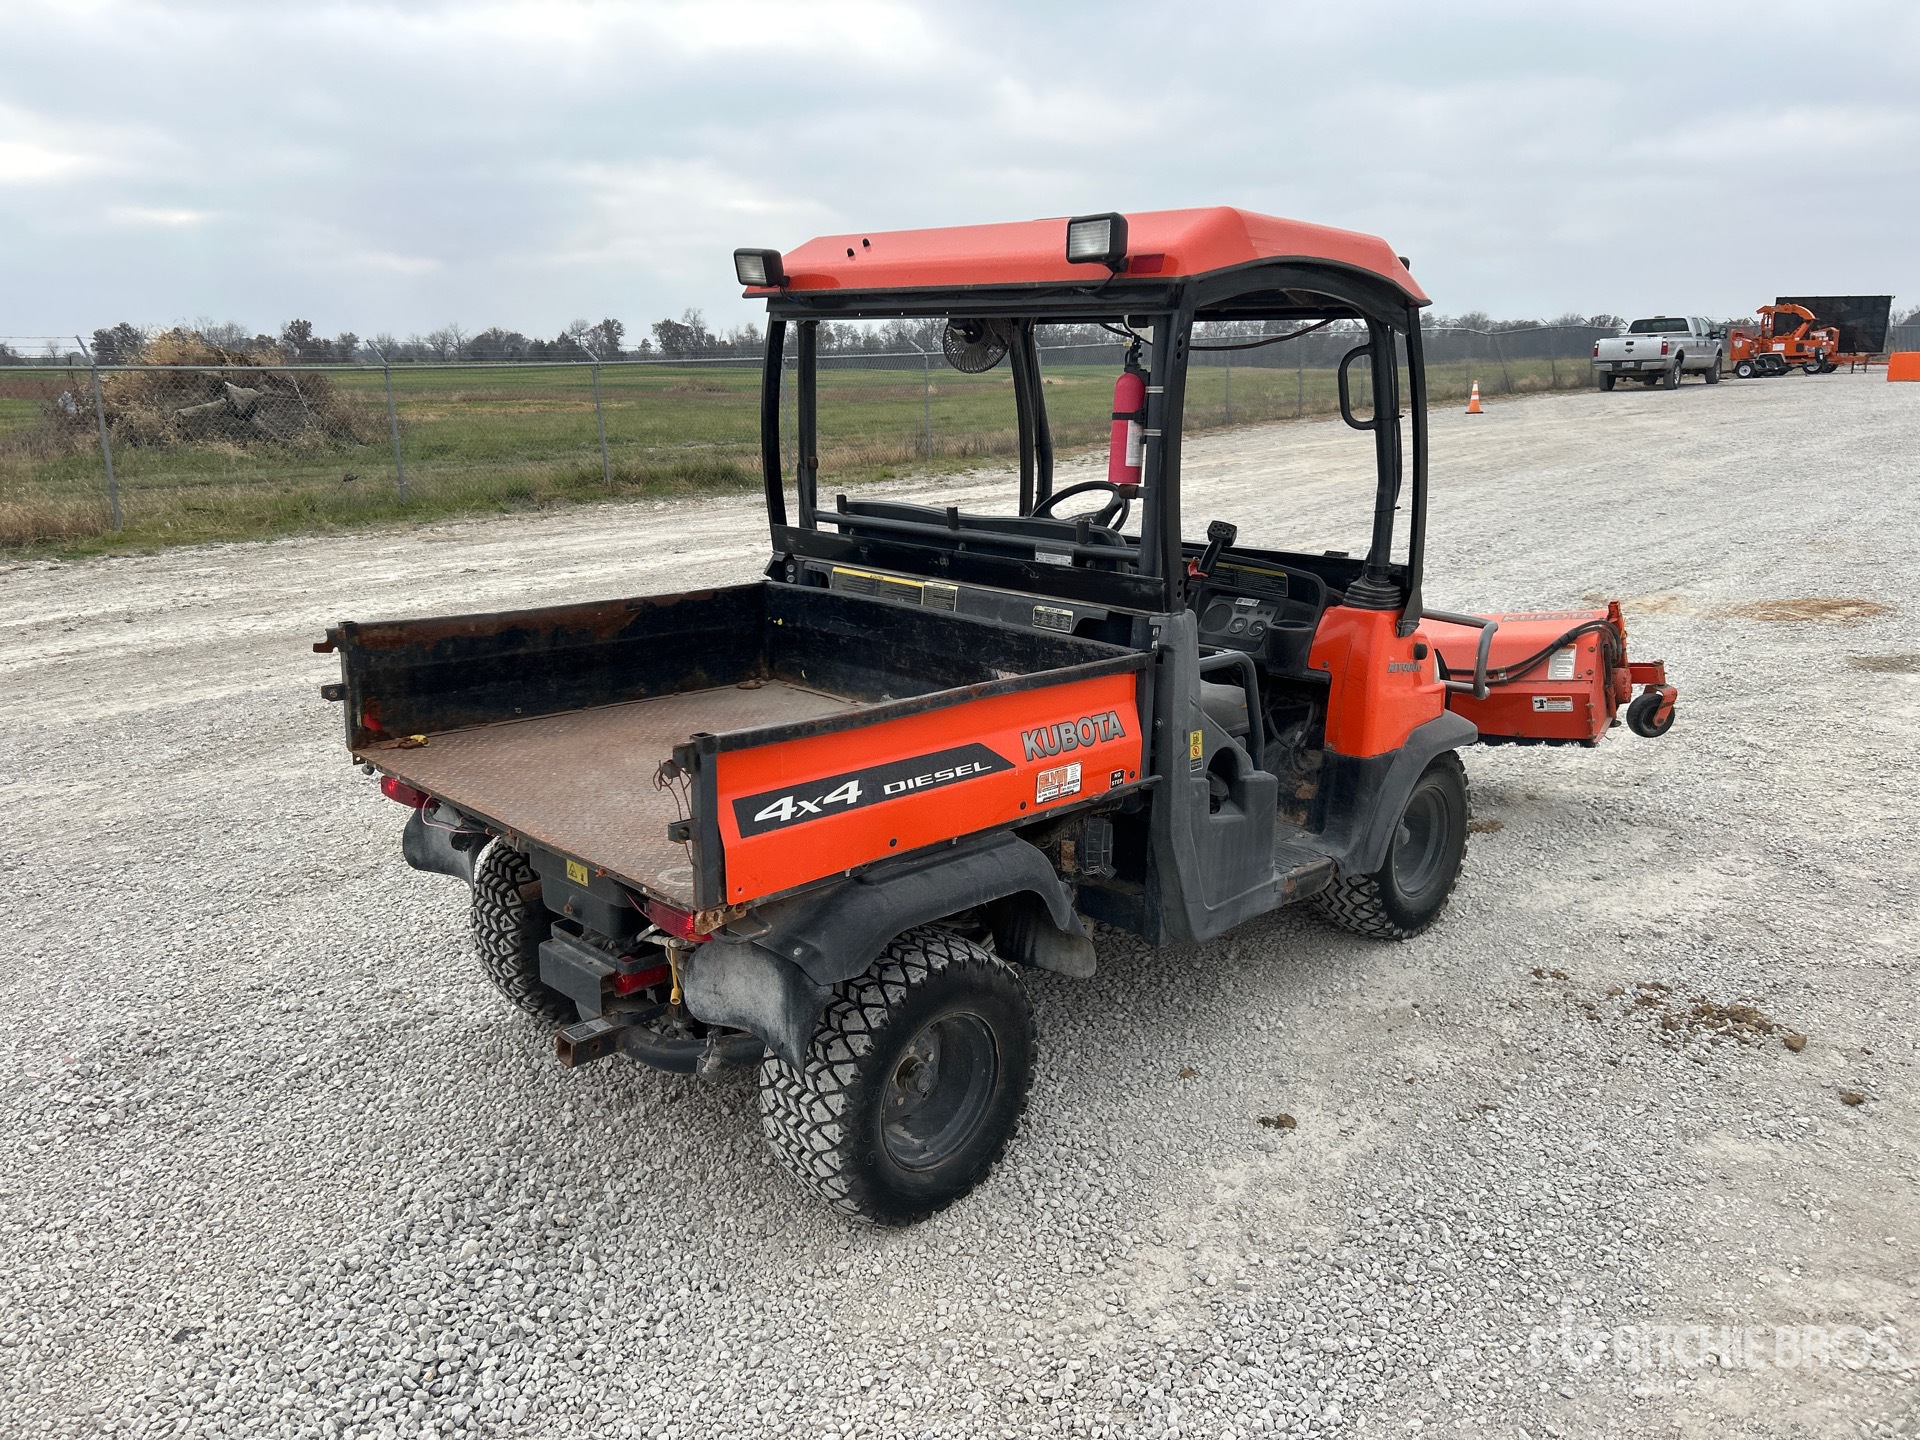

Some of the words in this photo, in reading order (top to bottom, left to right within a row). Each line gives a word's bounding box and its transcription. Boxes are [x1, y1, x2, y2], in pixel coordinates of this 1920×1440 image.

[1501, 612, 1595, 622] KUBOTA
[1021, 711, 1126, 762] KUBOTA
[754, 780, 863, 822] 4x4
[883, 762, 993, 795] DIESEL
[1111, 778, 1123, 787] STEP
